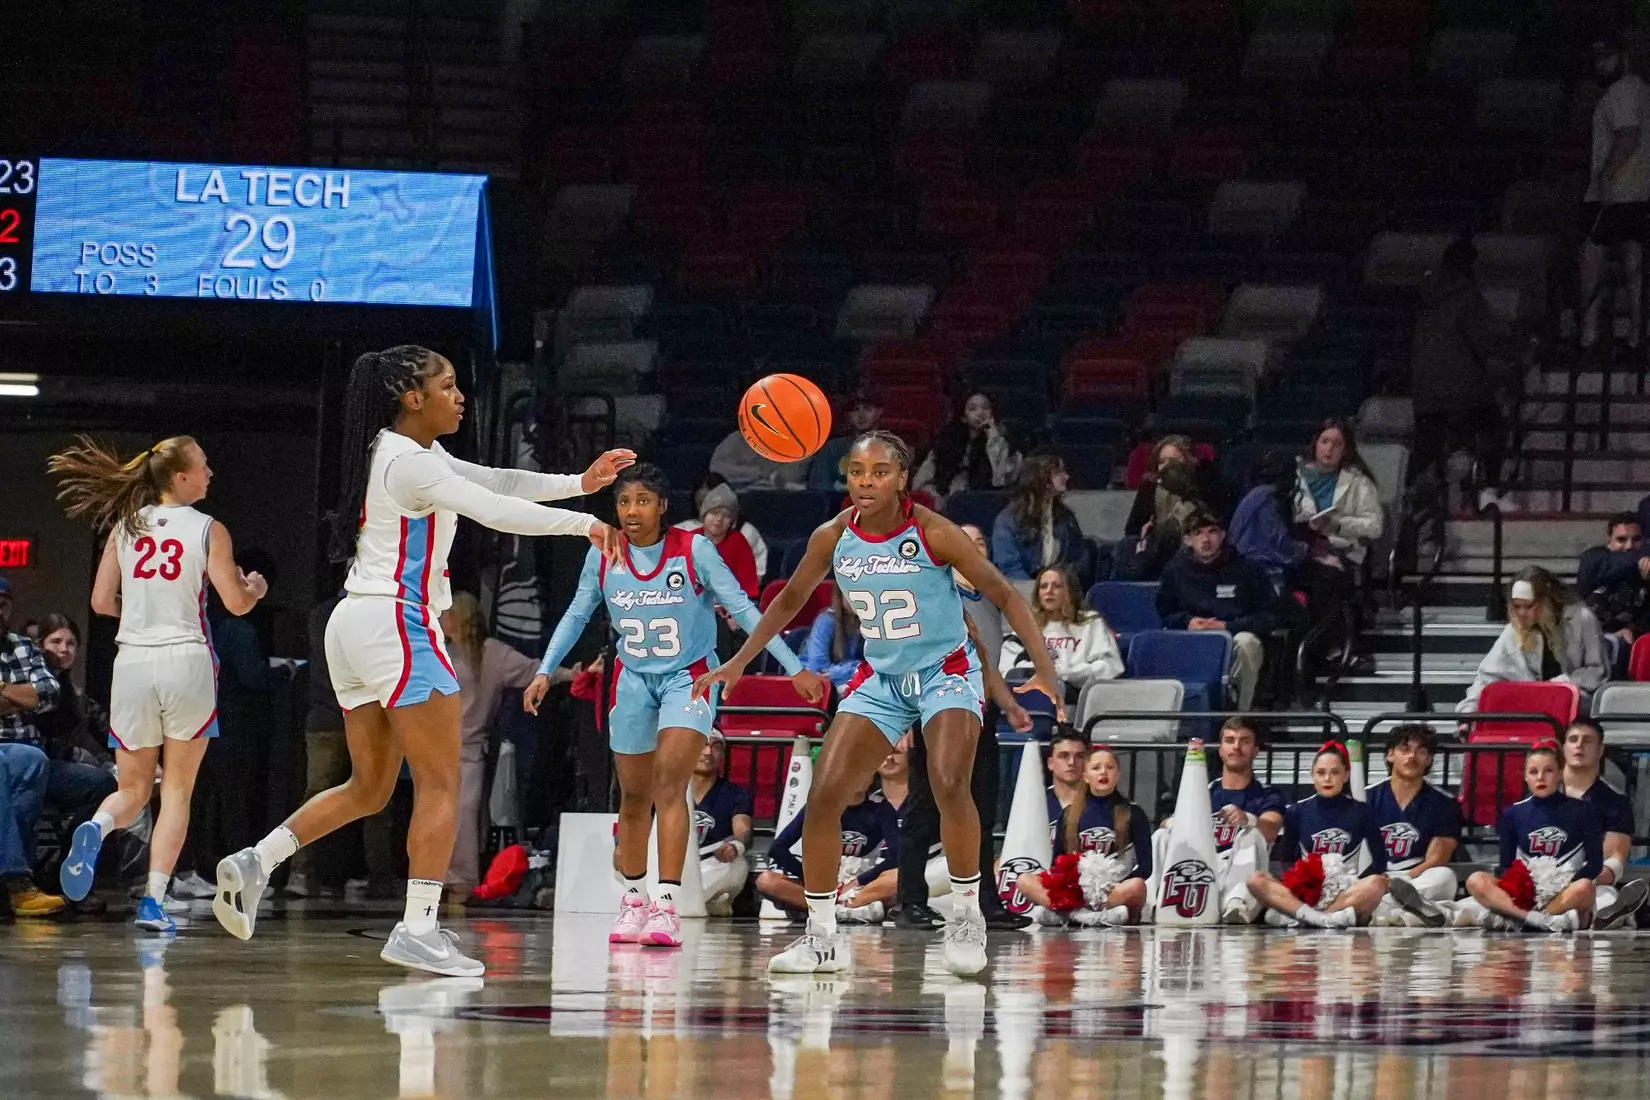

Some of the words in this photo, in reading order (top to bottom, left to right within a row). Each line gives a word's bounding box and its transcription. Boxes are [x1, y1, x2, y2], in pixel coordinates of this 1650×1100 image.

[0, 160, 34, 194] 23
[175, 169, 228, 203] LA
[241, 171, 350, 209] TECH
[81, 241, 156, 267] POSS
[221, 213, 296, 269] 29
[144, 273, 157, 296] 3
[198, 275, 289, 300] FOULS
[0, 540, 30, 567] EXIT
[133, 536, 184, 581] 23
[836, 556, 864, 582] Lady
[610, 589, 635, 612] Lady
[848, 589, 921, 640] 22
[619, 616, 681, 658] 23
[1043, 636, 1081, 652] ERTY
[1161, 872, 1210, 918] LU
